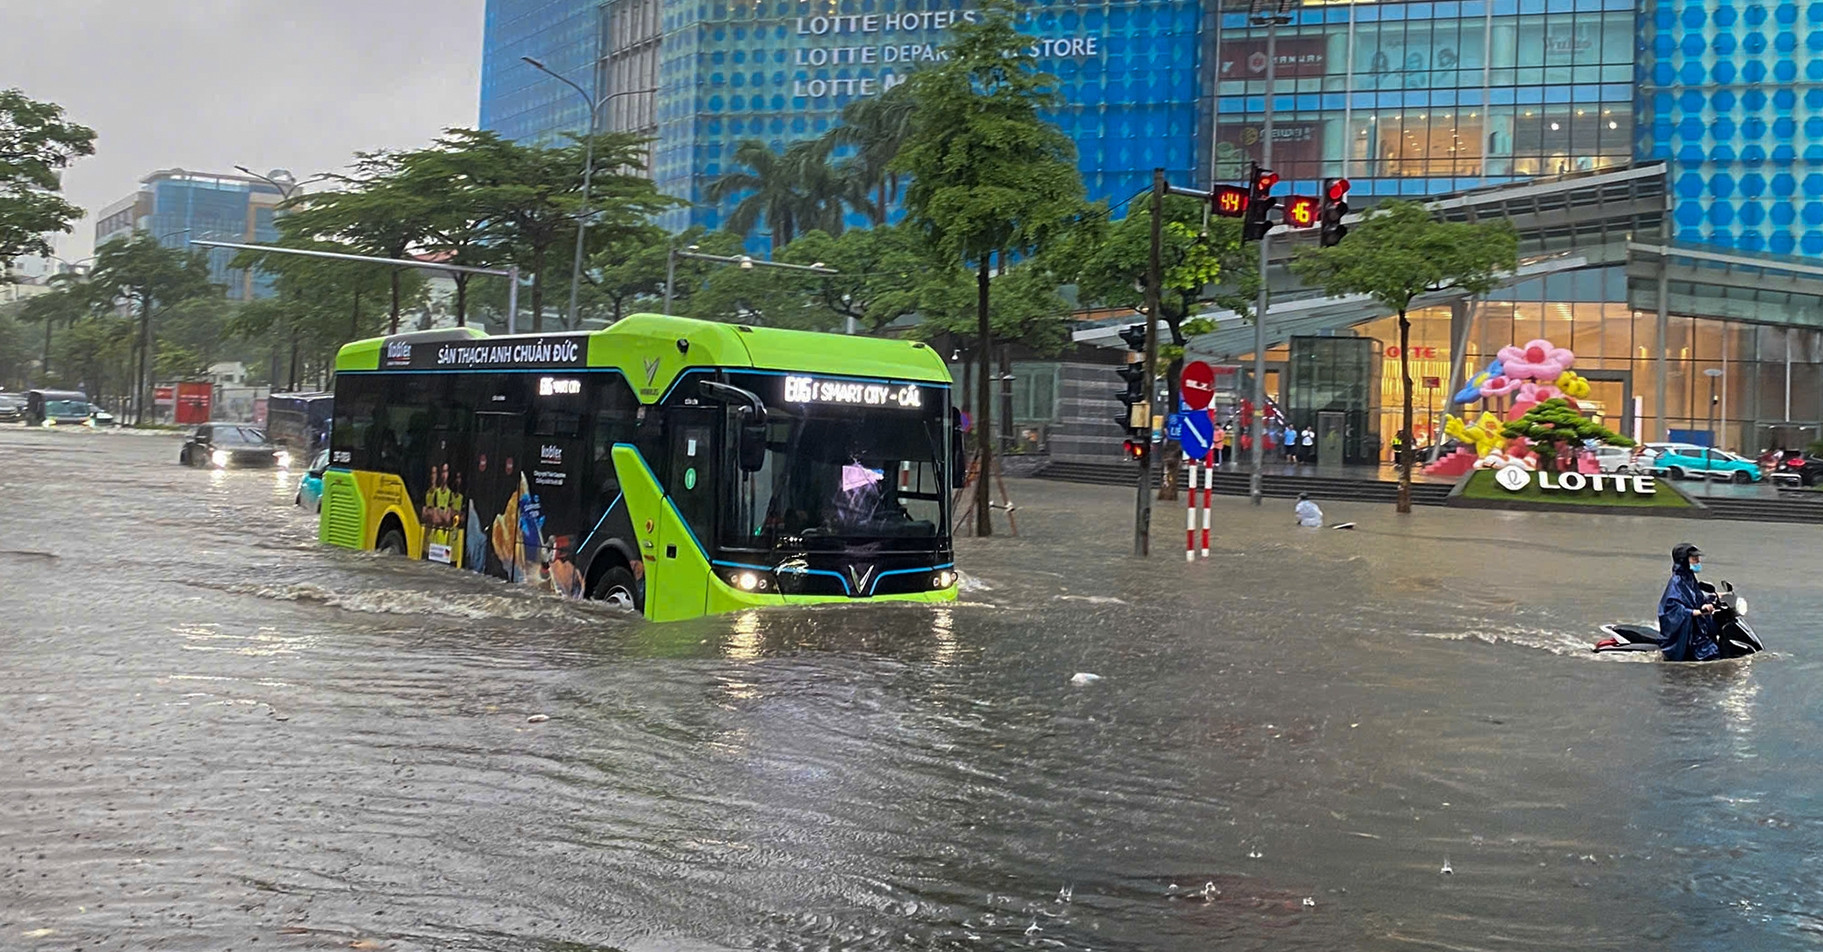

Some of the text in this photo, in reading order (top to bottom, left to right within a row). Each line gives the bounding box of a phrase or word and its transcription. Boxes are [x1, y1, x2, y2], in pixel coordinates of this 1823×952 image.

[797, 16, 878, 35] LOTTE
[796, 46, 876, 66] LOTTE
[1028, 37, 1098, 57] STORE
[793, 78, 875, 98] LOTTE
[1221, 192, 1239, 212] 44
[437, 338, 579, 367] SÀN THẠCH ANH CHUẨN ĐỨC
[820, 383, 864, 402] SMART
[864, 384, 890, 404] CITY
[1538, 471, 1657, 493] LOTTE
